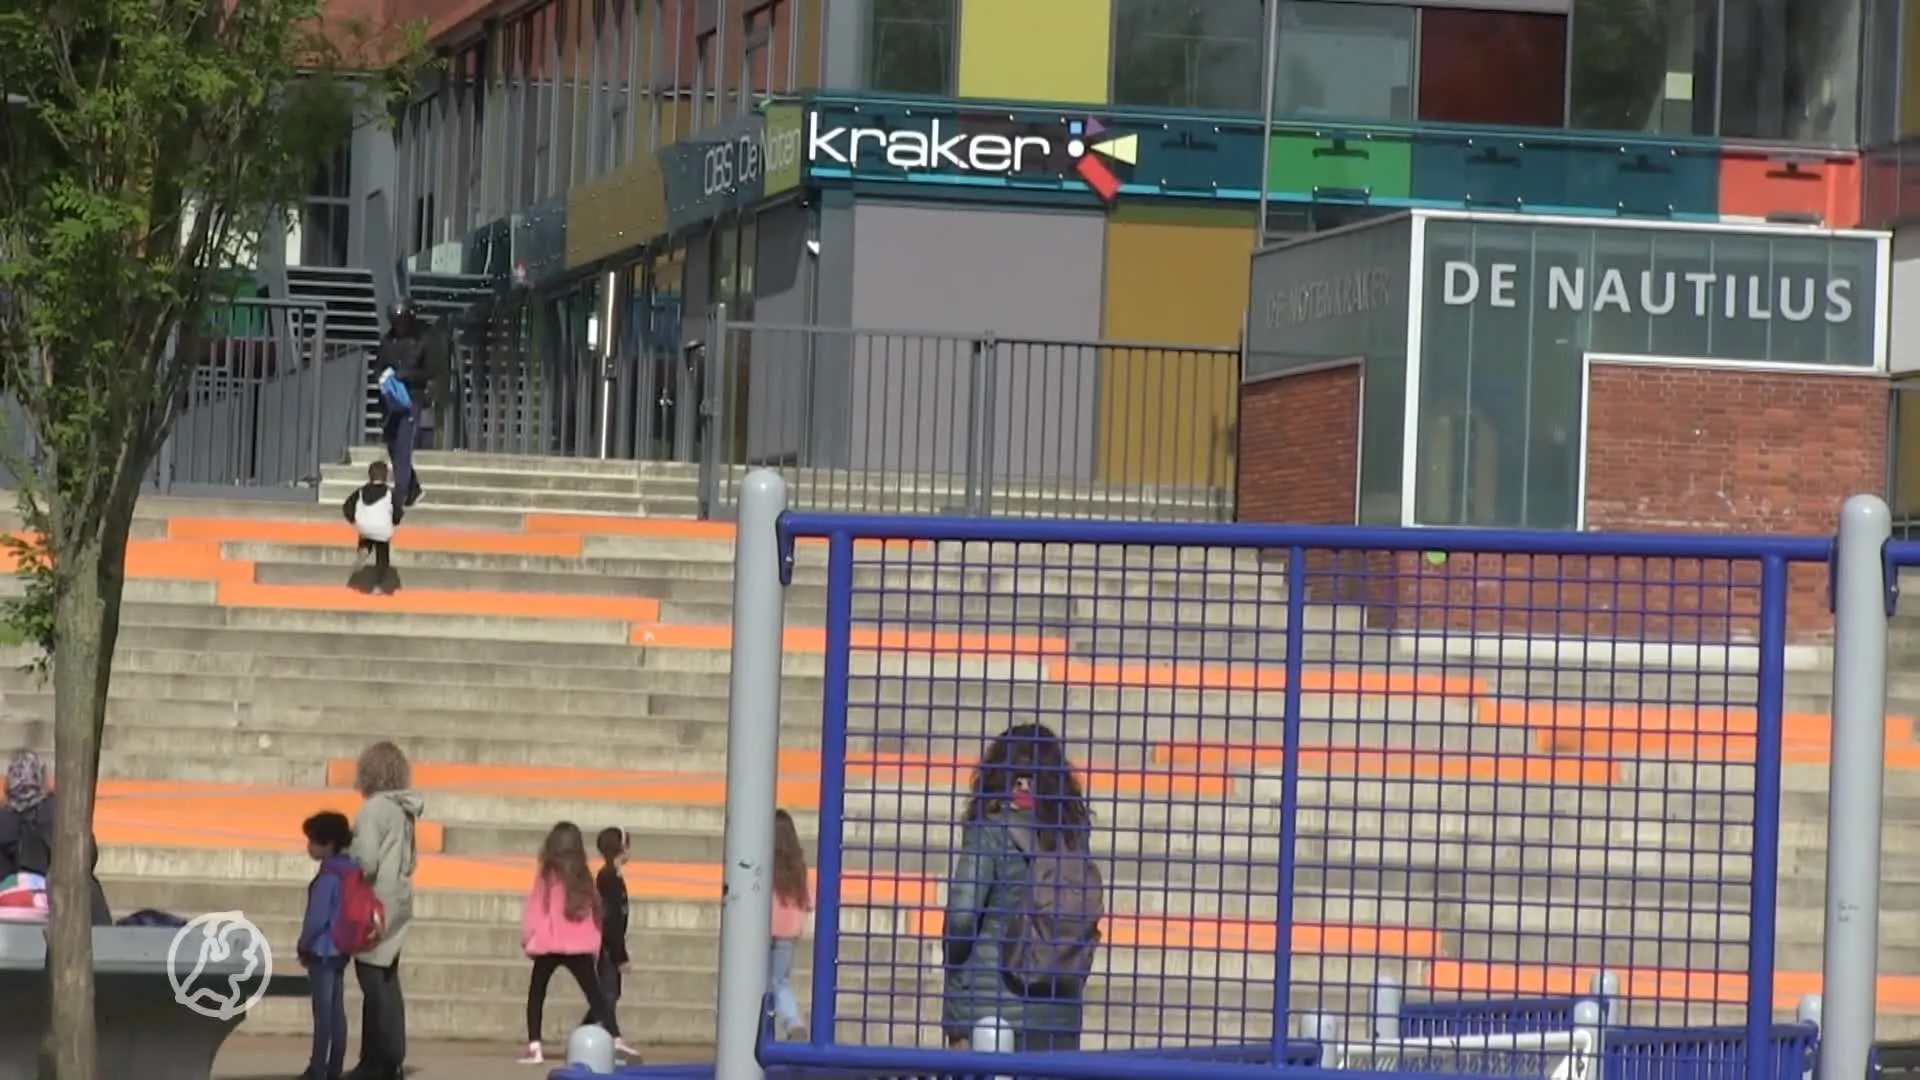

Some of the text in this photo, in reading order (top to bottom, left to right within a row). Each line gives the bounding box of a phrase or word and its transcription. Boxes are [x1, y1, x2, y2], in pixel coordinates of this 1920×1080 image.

[704, 141, 733, 195] OBS
[739, 136, 758, 182] De
[808, 111, 1050, 172] kraker
[1443, 260, 1853, 323] DE NAUTILUS
